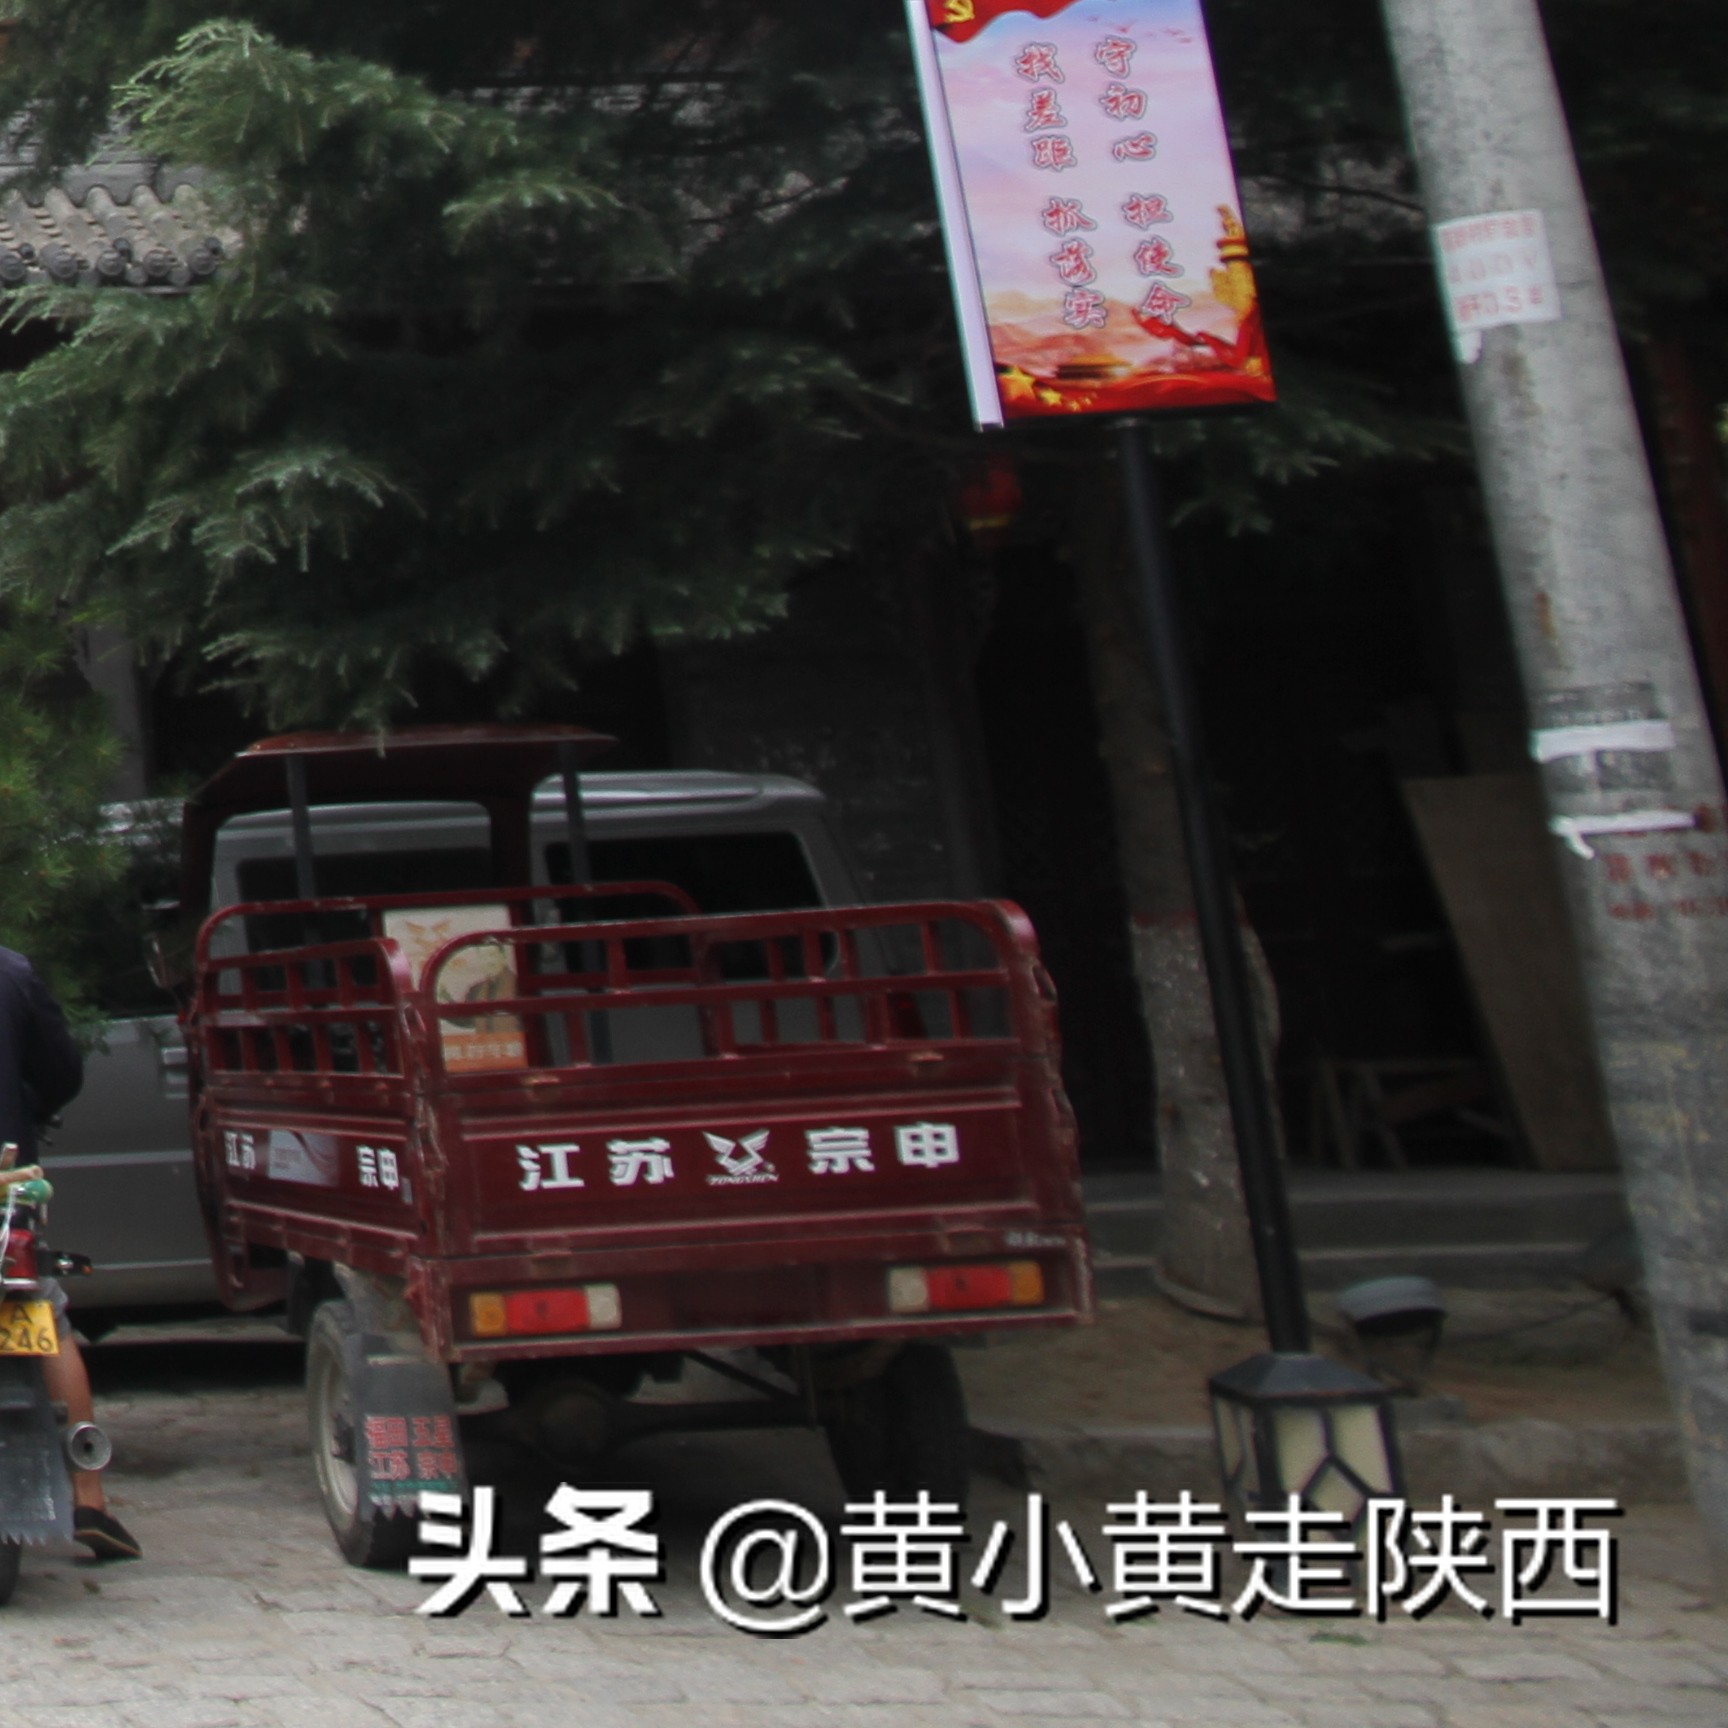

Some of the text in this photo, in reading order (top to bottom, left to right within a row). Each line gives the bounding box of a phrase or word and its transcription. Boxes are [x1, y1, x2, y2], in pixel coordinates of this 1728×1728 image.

[1016, 42, 1109, 329] 找差距 抓落实
[1095, 36, 1193, 325] 守初心 担使命
[225, 1131, 256, 1170] 江苏
[356, 1145, 401, 1191] 宗申
[517, 1123, 959, 1191] 江苏 宗申
